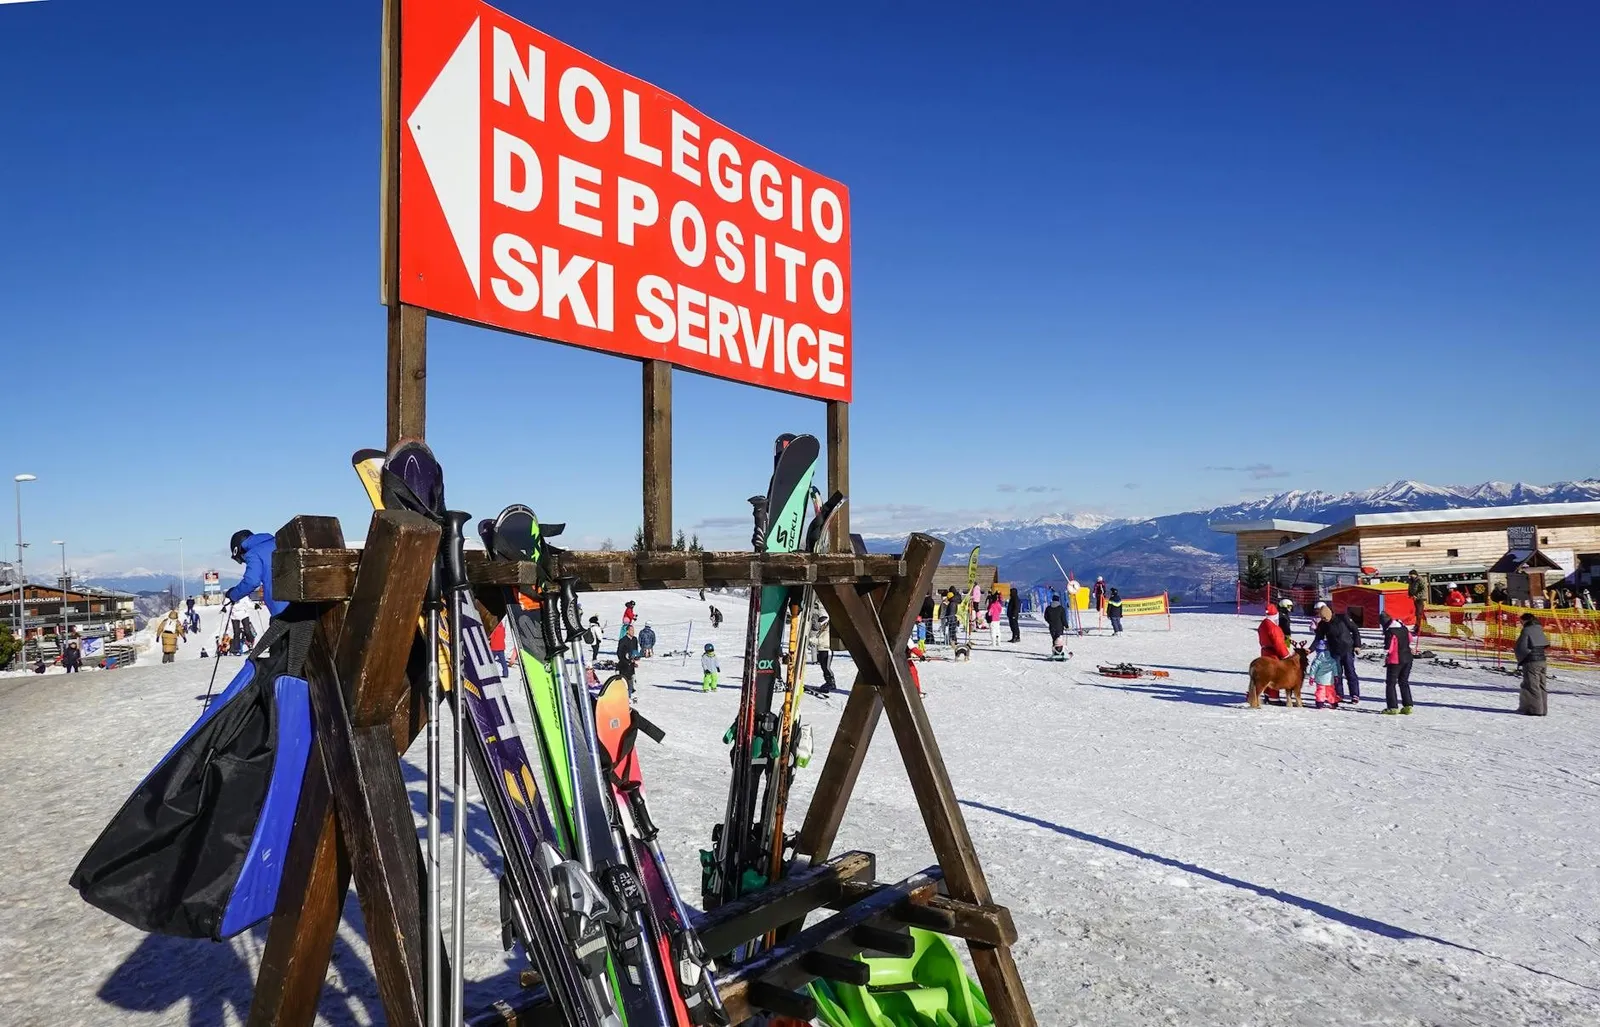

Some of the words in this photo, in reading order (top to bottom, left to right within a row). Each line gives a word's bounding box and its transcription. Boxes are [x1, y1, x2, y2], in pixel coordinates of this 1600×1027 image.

[493, 25, 844, 244] NOLEGGIO
[493, 127, 844, 314] DEPOSITO
[490, 232, 614, 332] SKI
[635, 274, 845, 388] SERVICE
